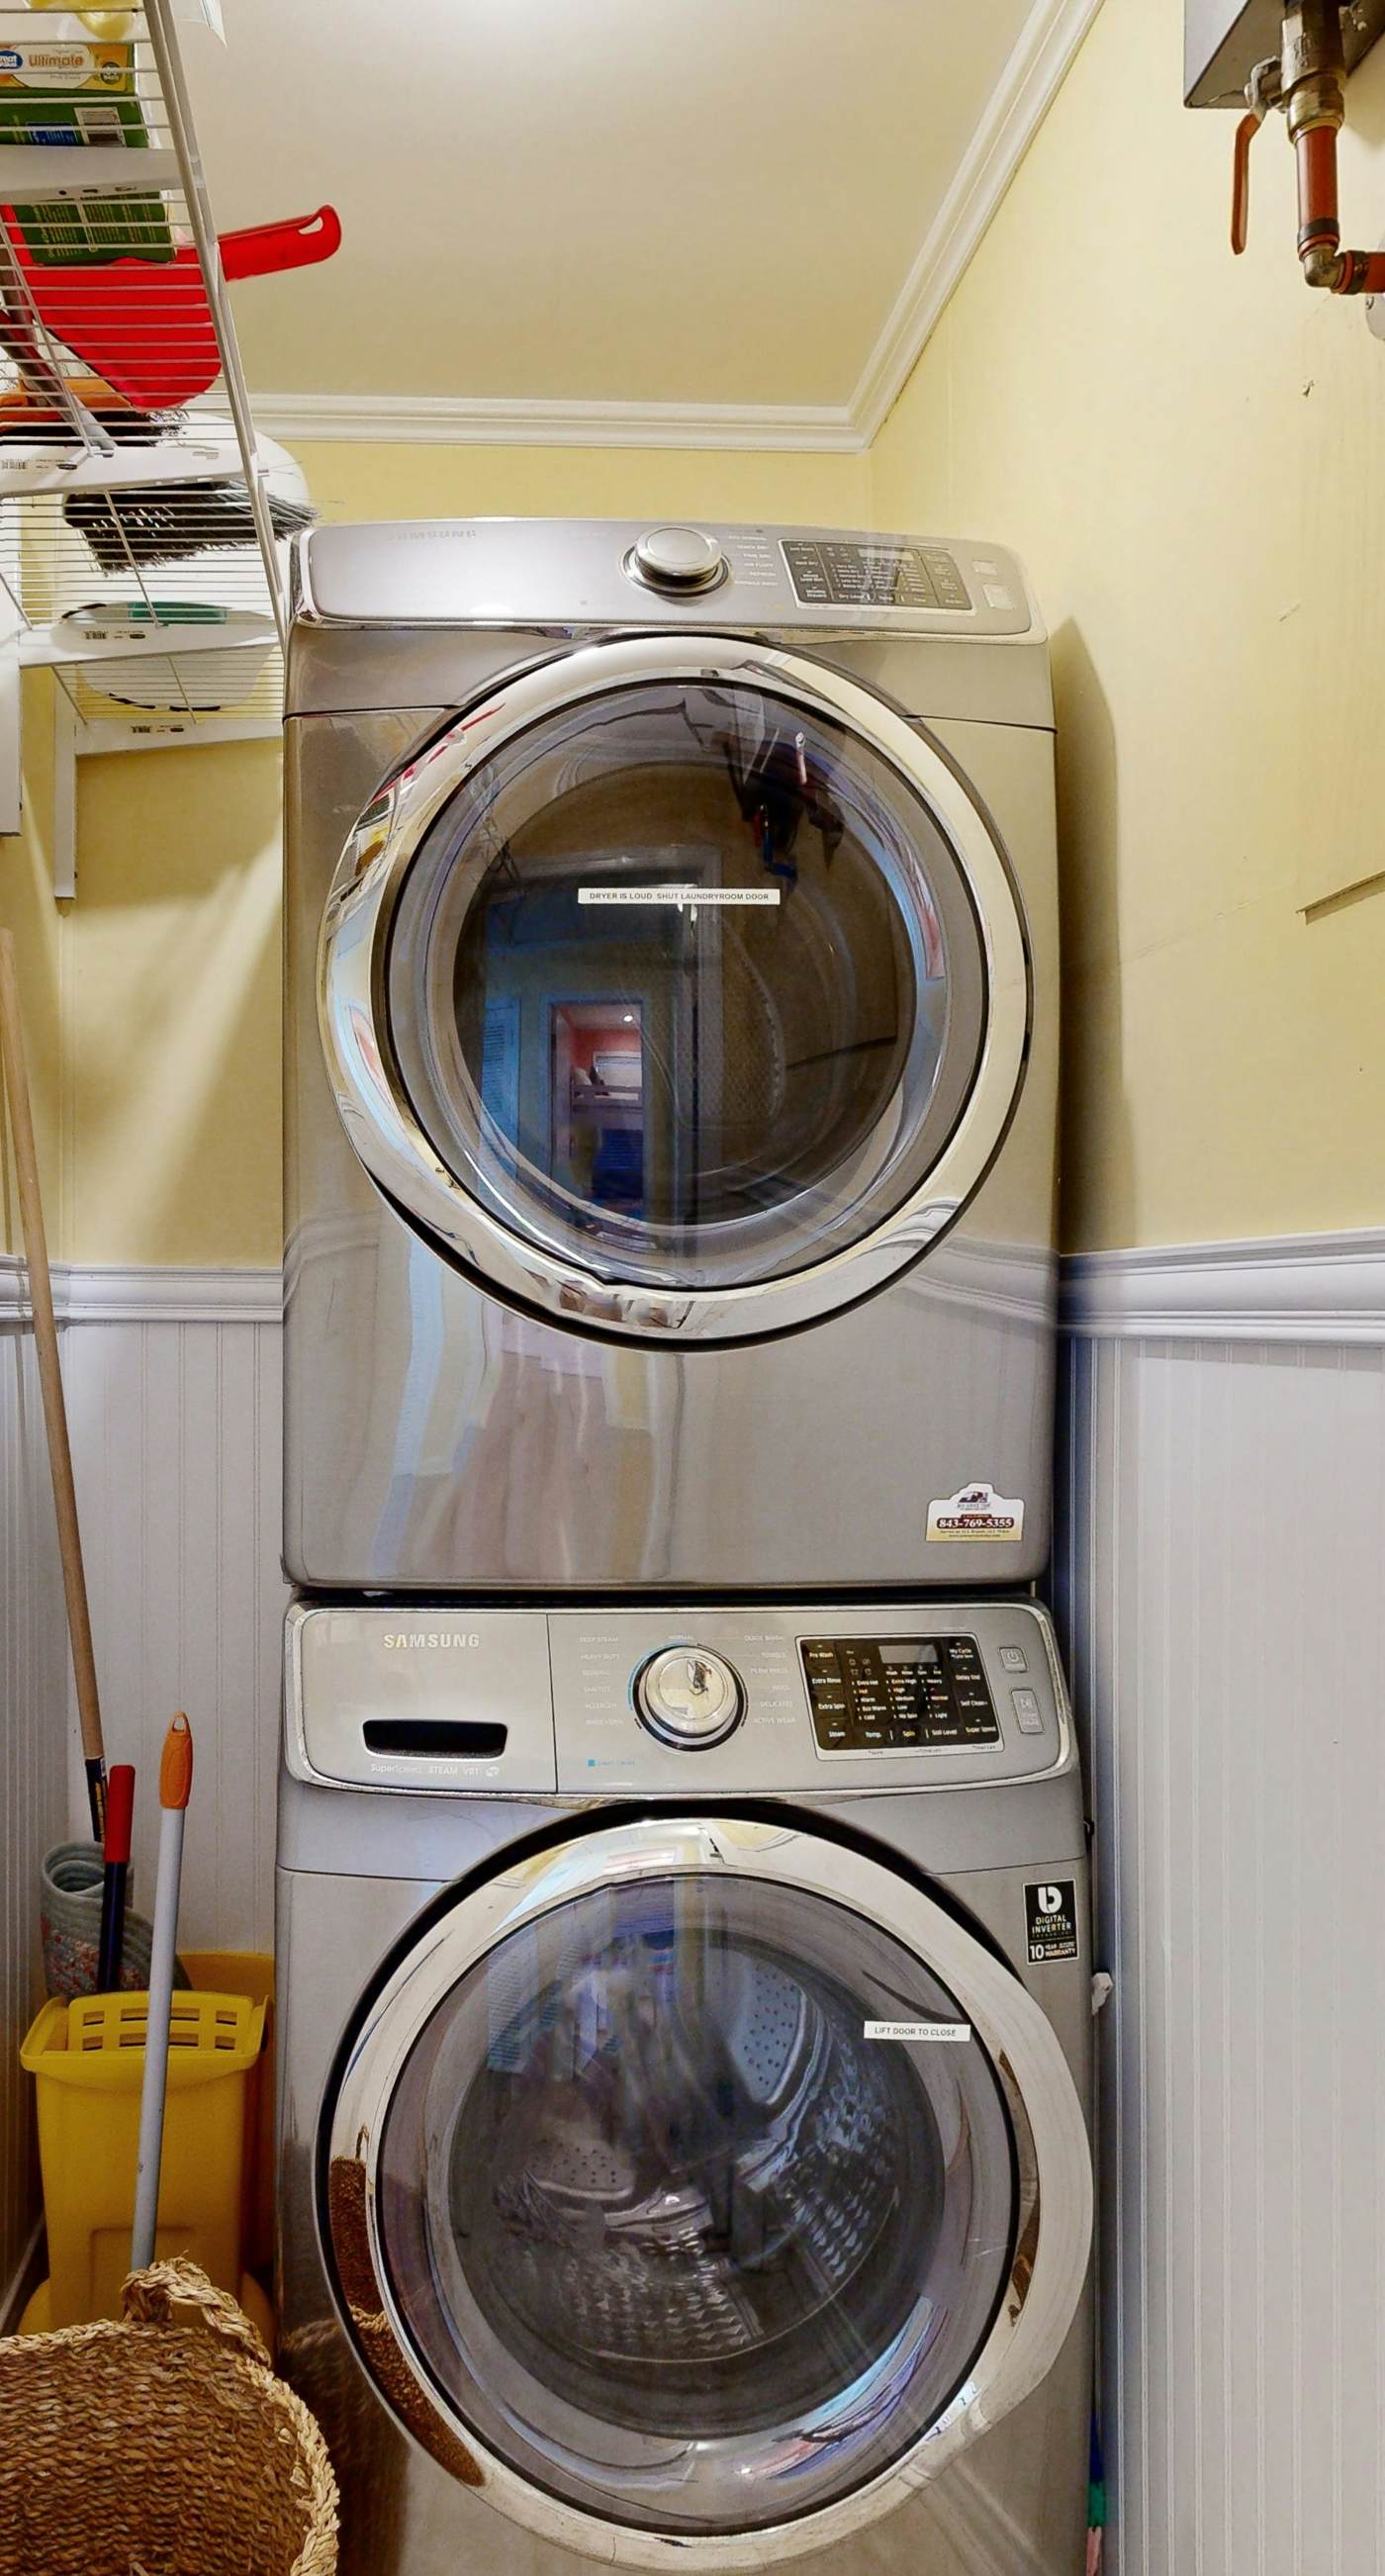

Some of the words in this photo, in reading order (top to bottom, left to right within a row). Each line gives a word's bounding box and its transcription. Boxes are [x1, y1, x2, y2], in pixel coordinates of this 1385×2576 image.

[939, 1518, 1012, 1527] 843-769-5355
[383, 1633, 480, 1649] SAMSUNG
[1035, 1914, 1067, 1925] DIGITAL
[1032, 1922, 1071, 1934] INVERTER
[1029, 1944, 1045, 1960] 10
